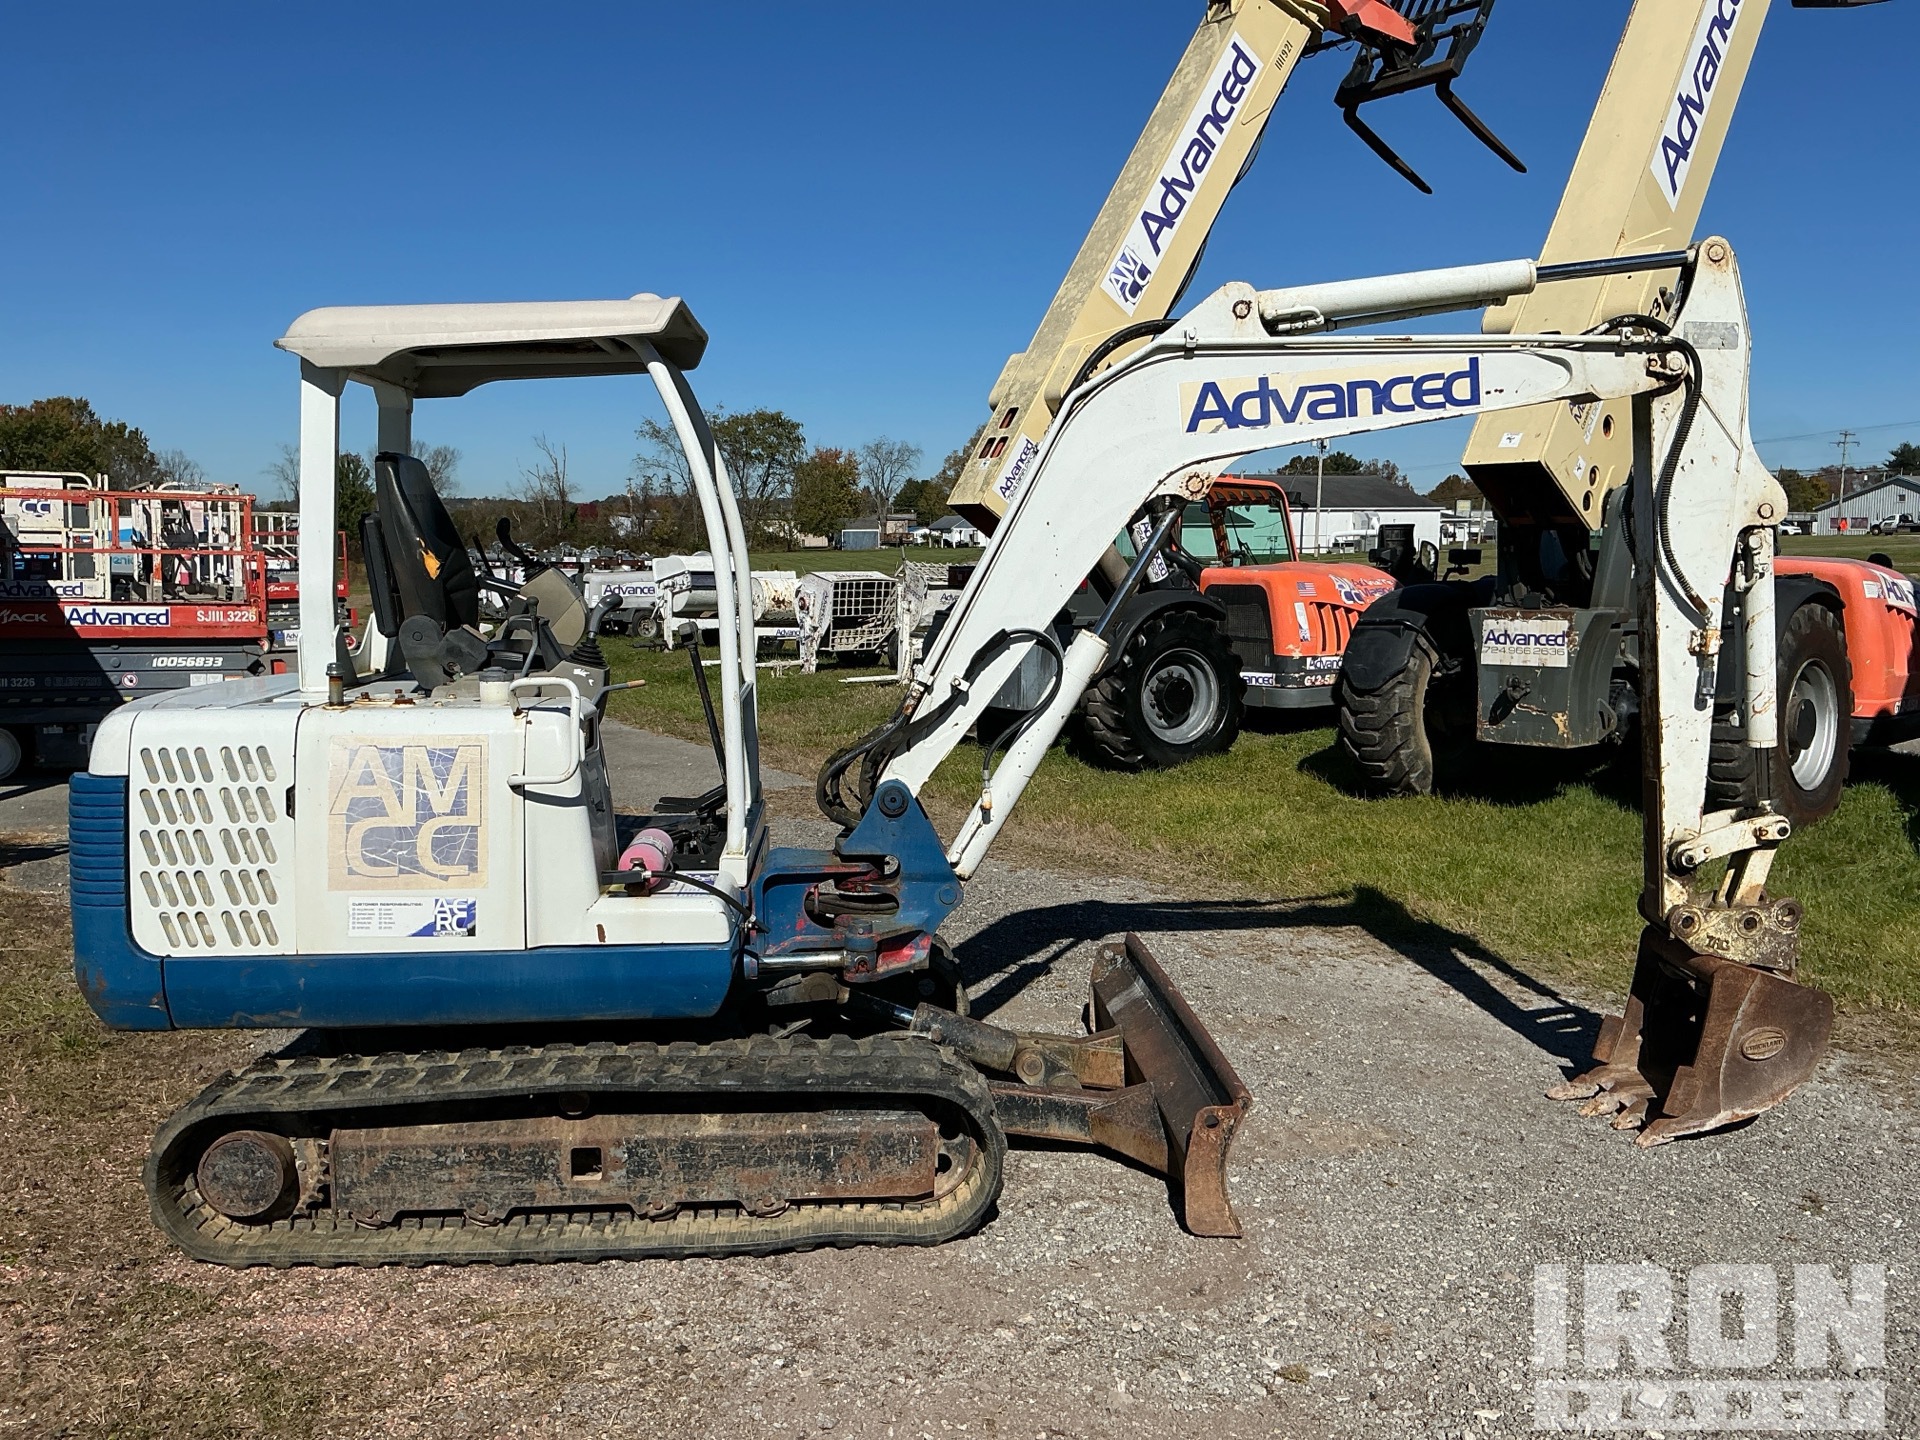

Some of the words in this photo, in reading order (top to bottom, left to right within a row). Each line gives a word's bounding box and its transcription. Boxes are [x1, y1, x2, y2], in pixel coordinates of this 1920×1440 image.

[1661, 0, 1739, 197] Advanc
[1141, 41, 1257, 257] Advanced
[1186, 357, 1481, 433] Advanced
[1000, 438, 1034, 498] Advanced
[0, 582, 84, 597] Advanced
[603, 584, 656, 596] Advance
[66, 607, 170, 626] Advanced
[227, 610, 257, 622] 3226
[776, 628, 800, 637] Advanc
[1484, 629, 1566, 646] Advanced
[152, 656, 223, 667] 10056833
[1309, 657, 1342, 669] Advanc
[11, 677, 36, 687] 3226
[1243, 675, 1274, 685] anced
